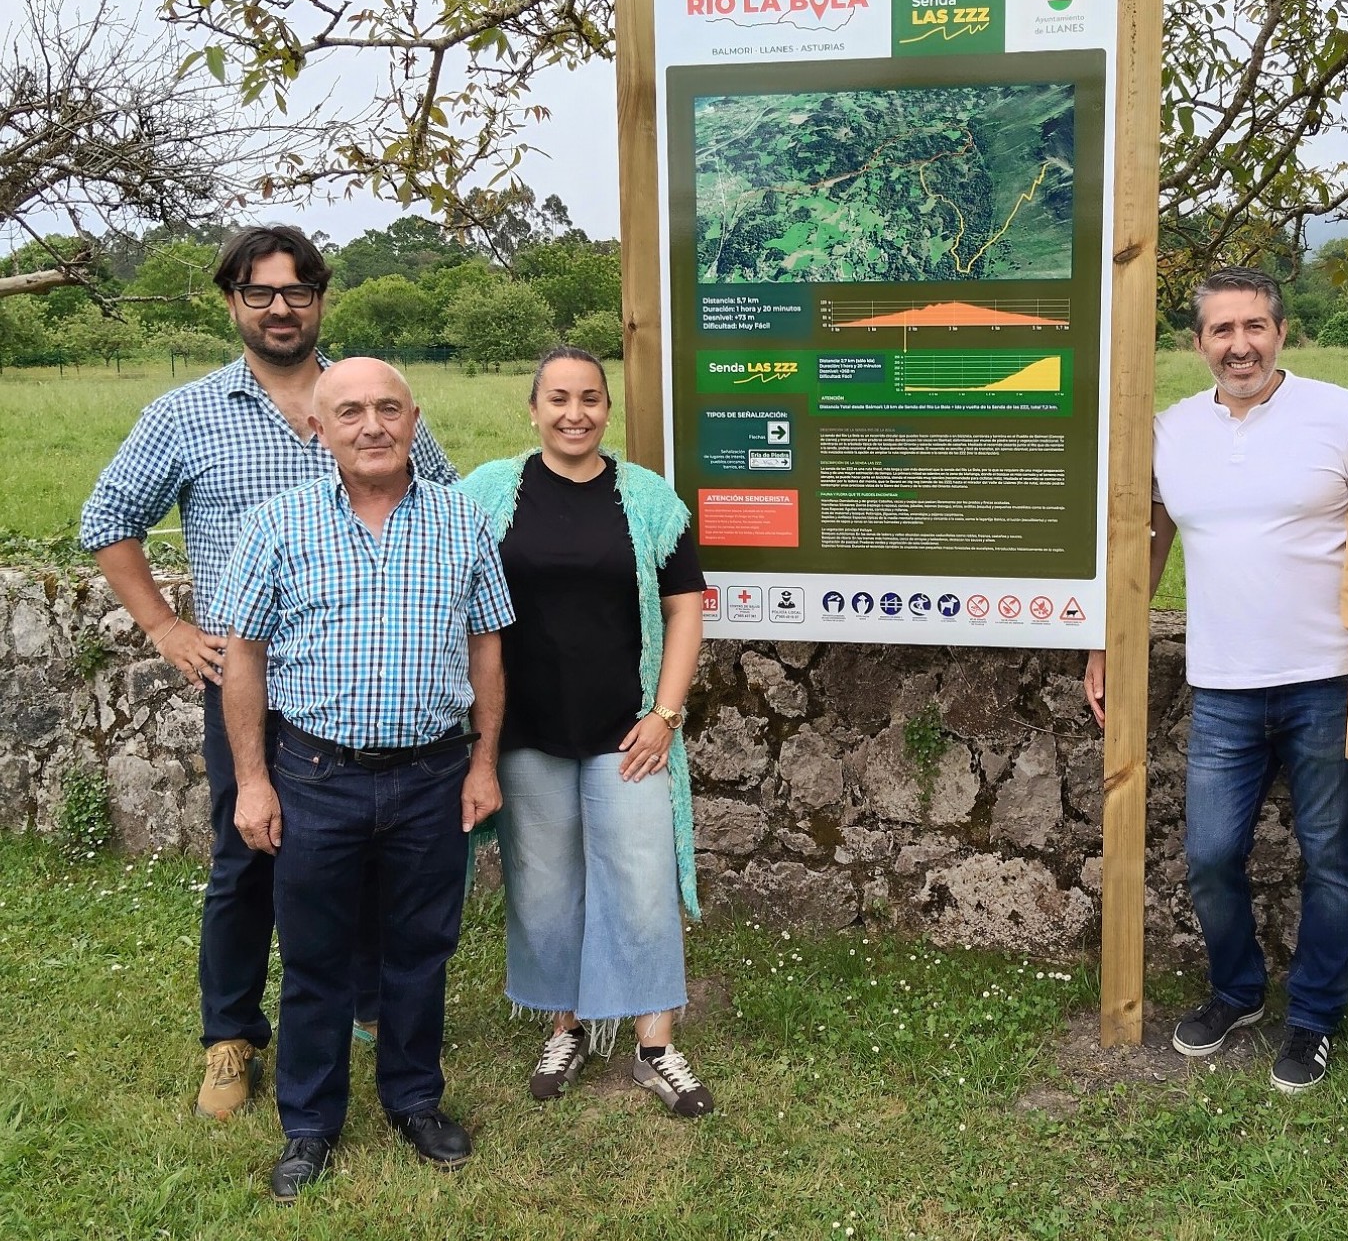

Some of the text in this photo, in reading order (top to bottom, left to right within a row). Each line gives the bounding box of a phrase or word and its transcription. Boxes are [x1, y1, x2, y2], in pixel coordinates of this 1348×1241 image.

[912, 7, 990, 25] LAS ZZZ
[1035, 14, 1085, 24] Ayuntamiento
[1034, 23, 1085, 35] de LLANES
[712, 42, 846, 56] BALMORI LLANES ASTURIAS
[736, 297, 747, 305] 5,7
[703, 322, 771, 331] Dificultad: Muy Fácil
[709, 362, 798, 373] Senda LAS ZZZ
[737, 410, 788, 419] SEÑALIZACIÓN:
[706, 494, 744, 502] ATENCIÓN
